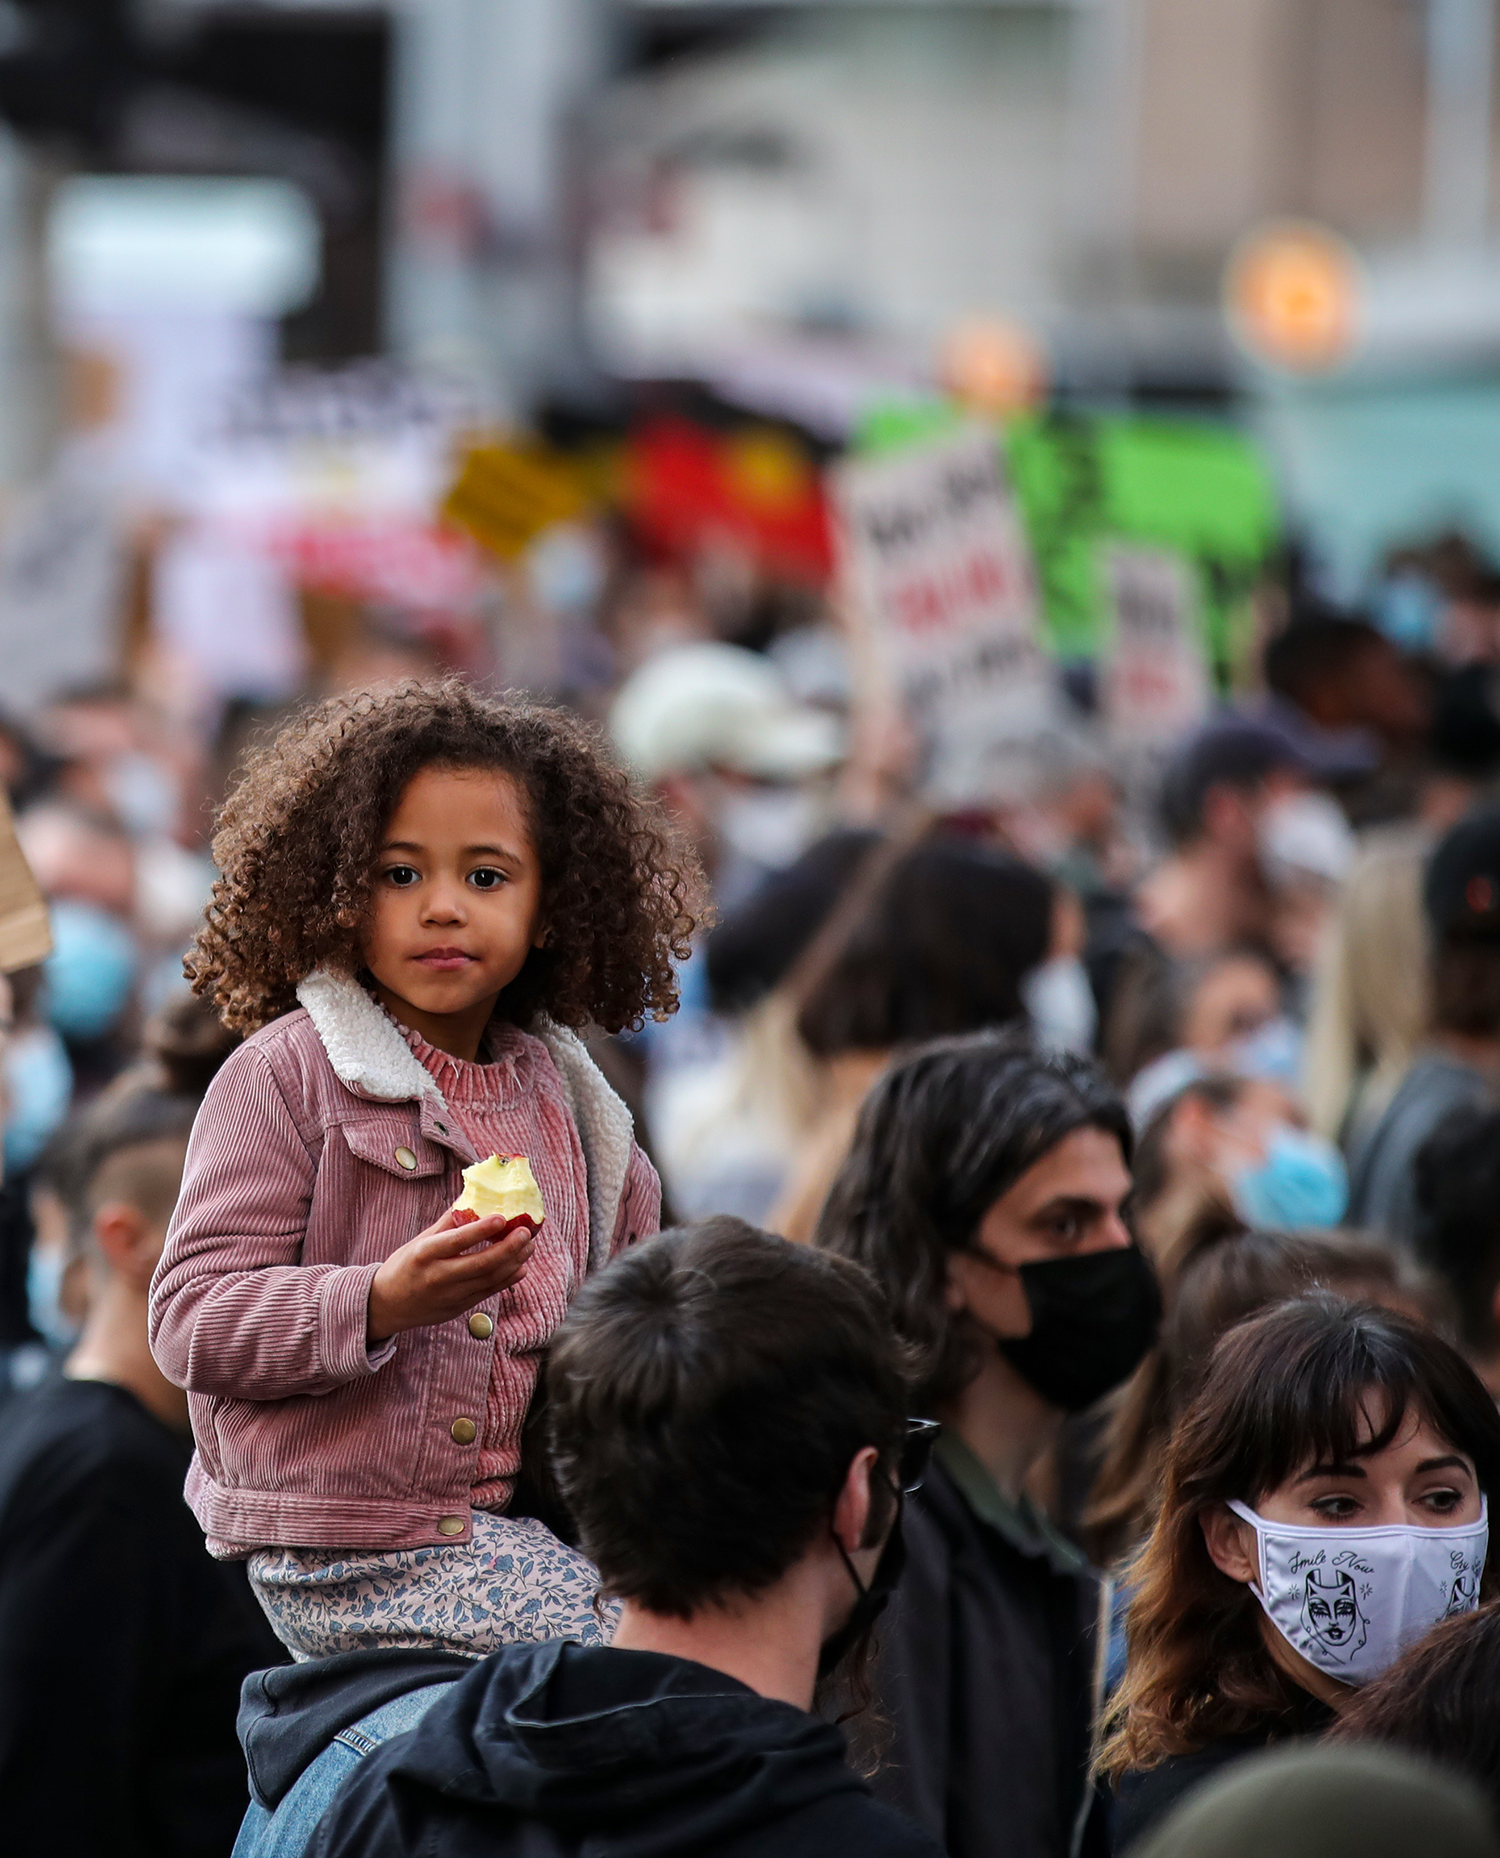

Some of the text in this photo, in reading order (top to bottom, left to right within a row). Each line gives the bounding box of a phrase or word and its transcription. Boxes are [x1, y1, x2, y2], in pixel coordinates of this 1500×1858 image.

[1288, 1549, 1375, 1575] Smile Now
[1450, 1550, 1470, 1577] Cry
